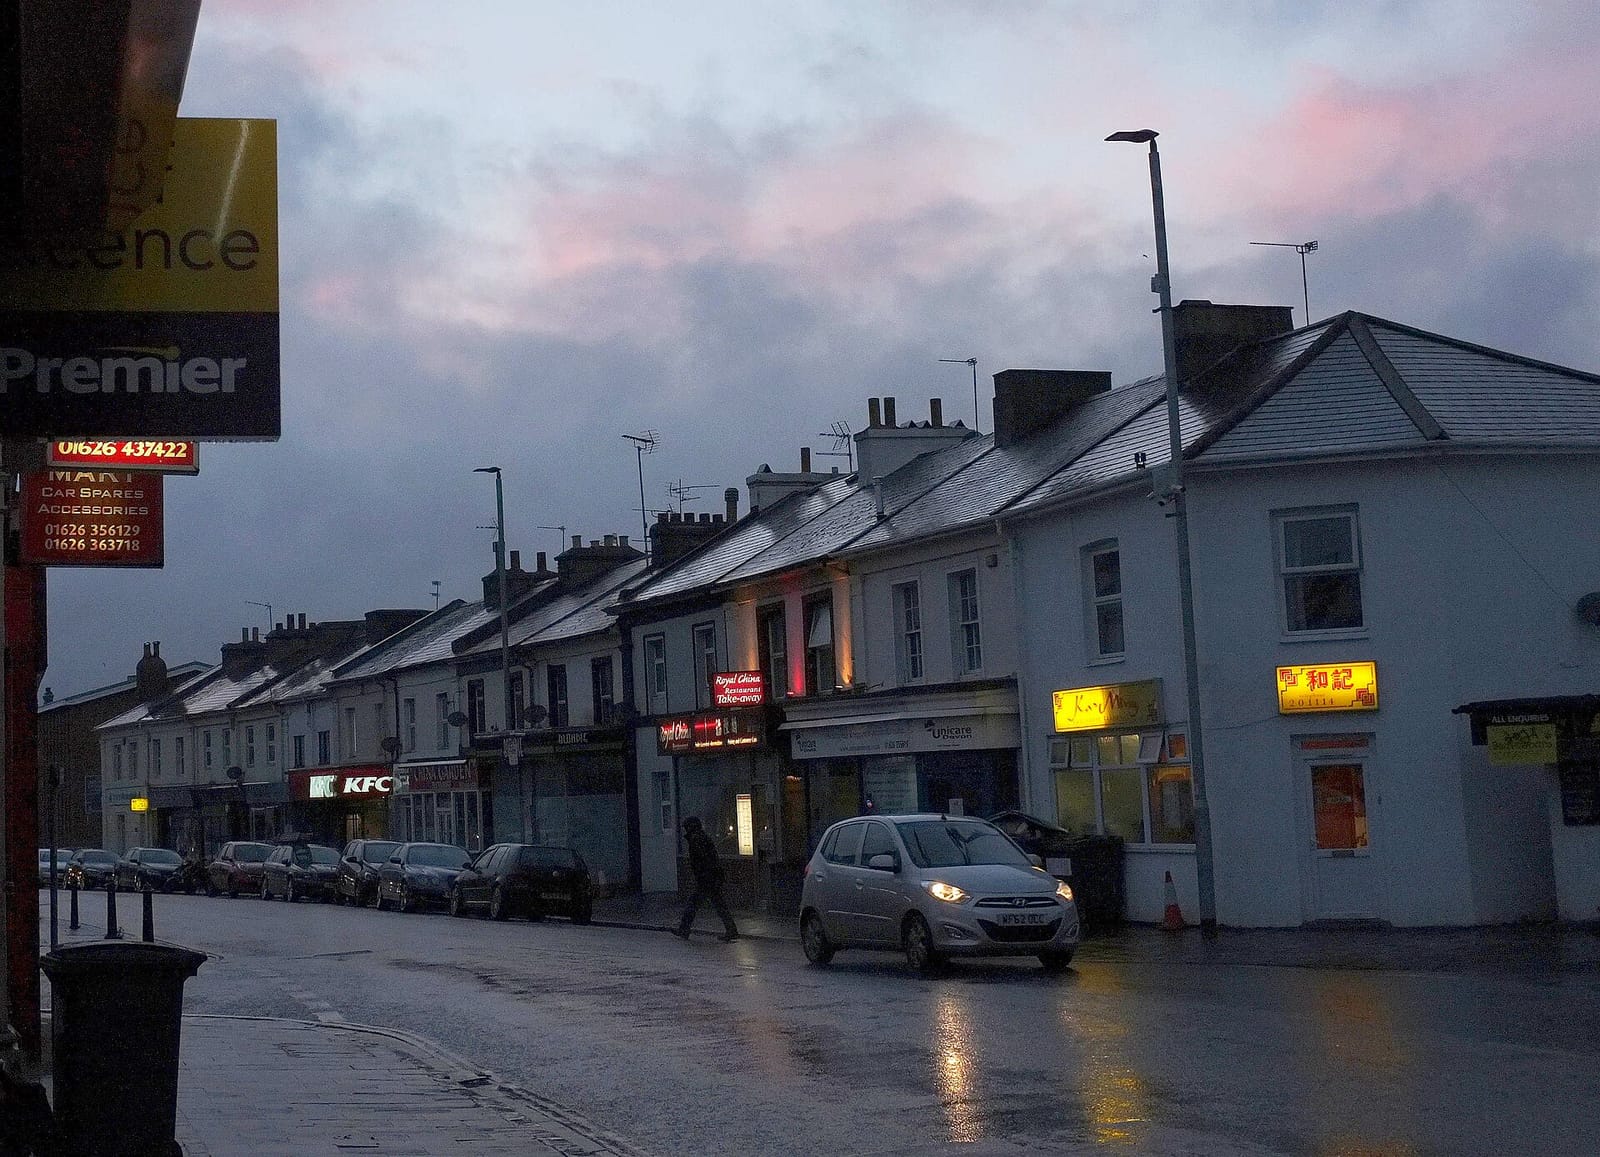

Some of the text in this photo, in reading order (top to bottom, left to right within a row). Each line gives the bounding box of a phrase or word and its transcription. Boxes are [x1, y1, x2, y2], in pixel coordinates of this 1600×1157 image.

[0, 347, 247, 394] Premier
[58, 442, 188, 458] 01626 437422
[45, 524, 140, 536] 01626 356129
[45, 539, 140, 551] 01626 363718
[715, 673, 760, 688] Royal China
[1306, 668, 1354, 691] 和記
[716, 693, 762, 704] Take-away
[724, 687, 761, 695] Restaurant
[932, 725, 972, 740] Unicare
[342, 776, 393, 794] KFC
